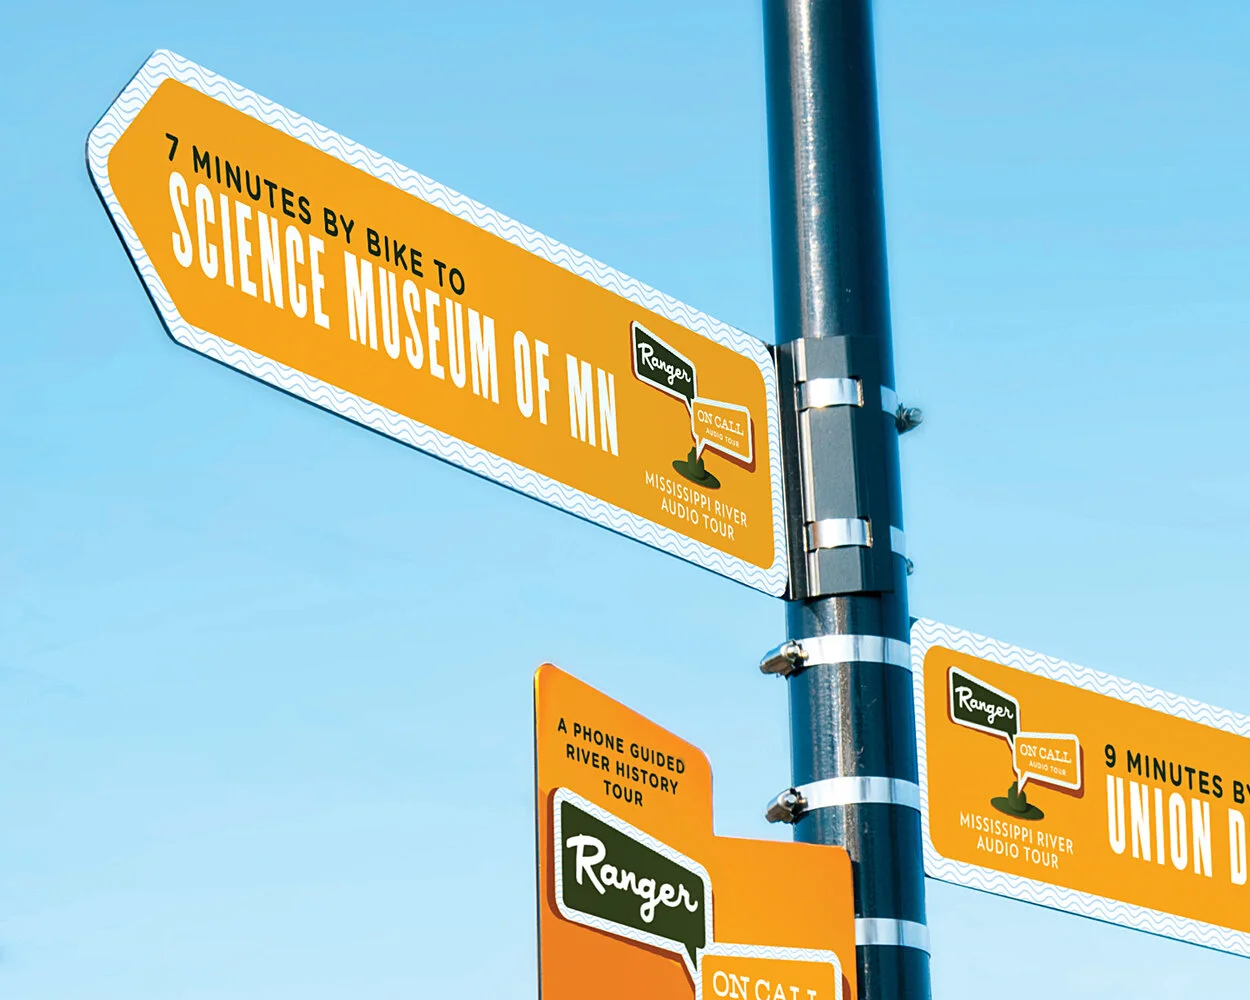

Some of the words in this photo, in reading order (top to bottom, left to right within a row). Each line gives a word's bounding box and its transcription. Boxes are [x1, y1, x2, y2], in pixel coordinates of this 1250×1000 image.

[164, 132, 180, 161] 7
[192, 144, 313, 225] MINUTES
[323, 207, 356, 245] BY
[367, 229, 424, 280] BIKE
[433, 260, 466, 296] TO
[168, 170, 330, 329] SCIENCE
[345, 252, 500, 405] MUSEUM
[513, 330, 550, 426] OF
[567, 353, 620, 457] MN
[638, 342, 691, 385] Ranger
[697, 409, 712, 425] ON
[714, 415, 744, 436] CALL
[706, 427, 723, 441] AUDIO
[725, 435, 739, 448] TOUR
[645, 470, 711, 512] MISSISSIPPI
[714, 500, 748, 527] RIVER
[661, 497, 699, 525] AUDIO
[702, 514, 735, 541] TOUR
[955, 686, 1014, 725] Ranger
[557, 717, 567, 734] A
[573, 722, 624, 753] PHONE
[630, 743, 685, 774] GUIDED
[1020, 744, 1037, 757] ON
[1039, 748, 1071, 764] CALL
[566, 744, 610, 772] RIVER
[616, 760, 678, 795] HISTORY
[1029, 760, 1048, 771] AUDIO
[1050, 765, 1066, 776] TOUR
[1105, 744, 1116, 766] 9
[1126, 750, 1224, 799] MINUTES
[603, 780, 643, 807] TOUR
[960, 811, 1033, 844] MISSISSIPPI
[1037, 831, 1074, 854] RIVER
[1106, 775, 1213, 878] UNION
[977, 835, 1019, 858] AUDIO
[1023, 847, 1059, 869] TOUR
[566, 833, 698, 923] Ranger
[712, 969, 750, 1000] ON
